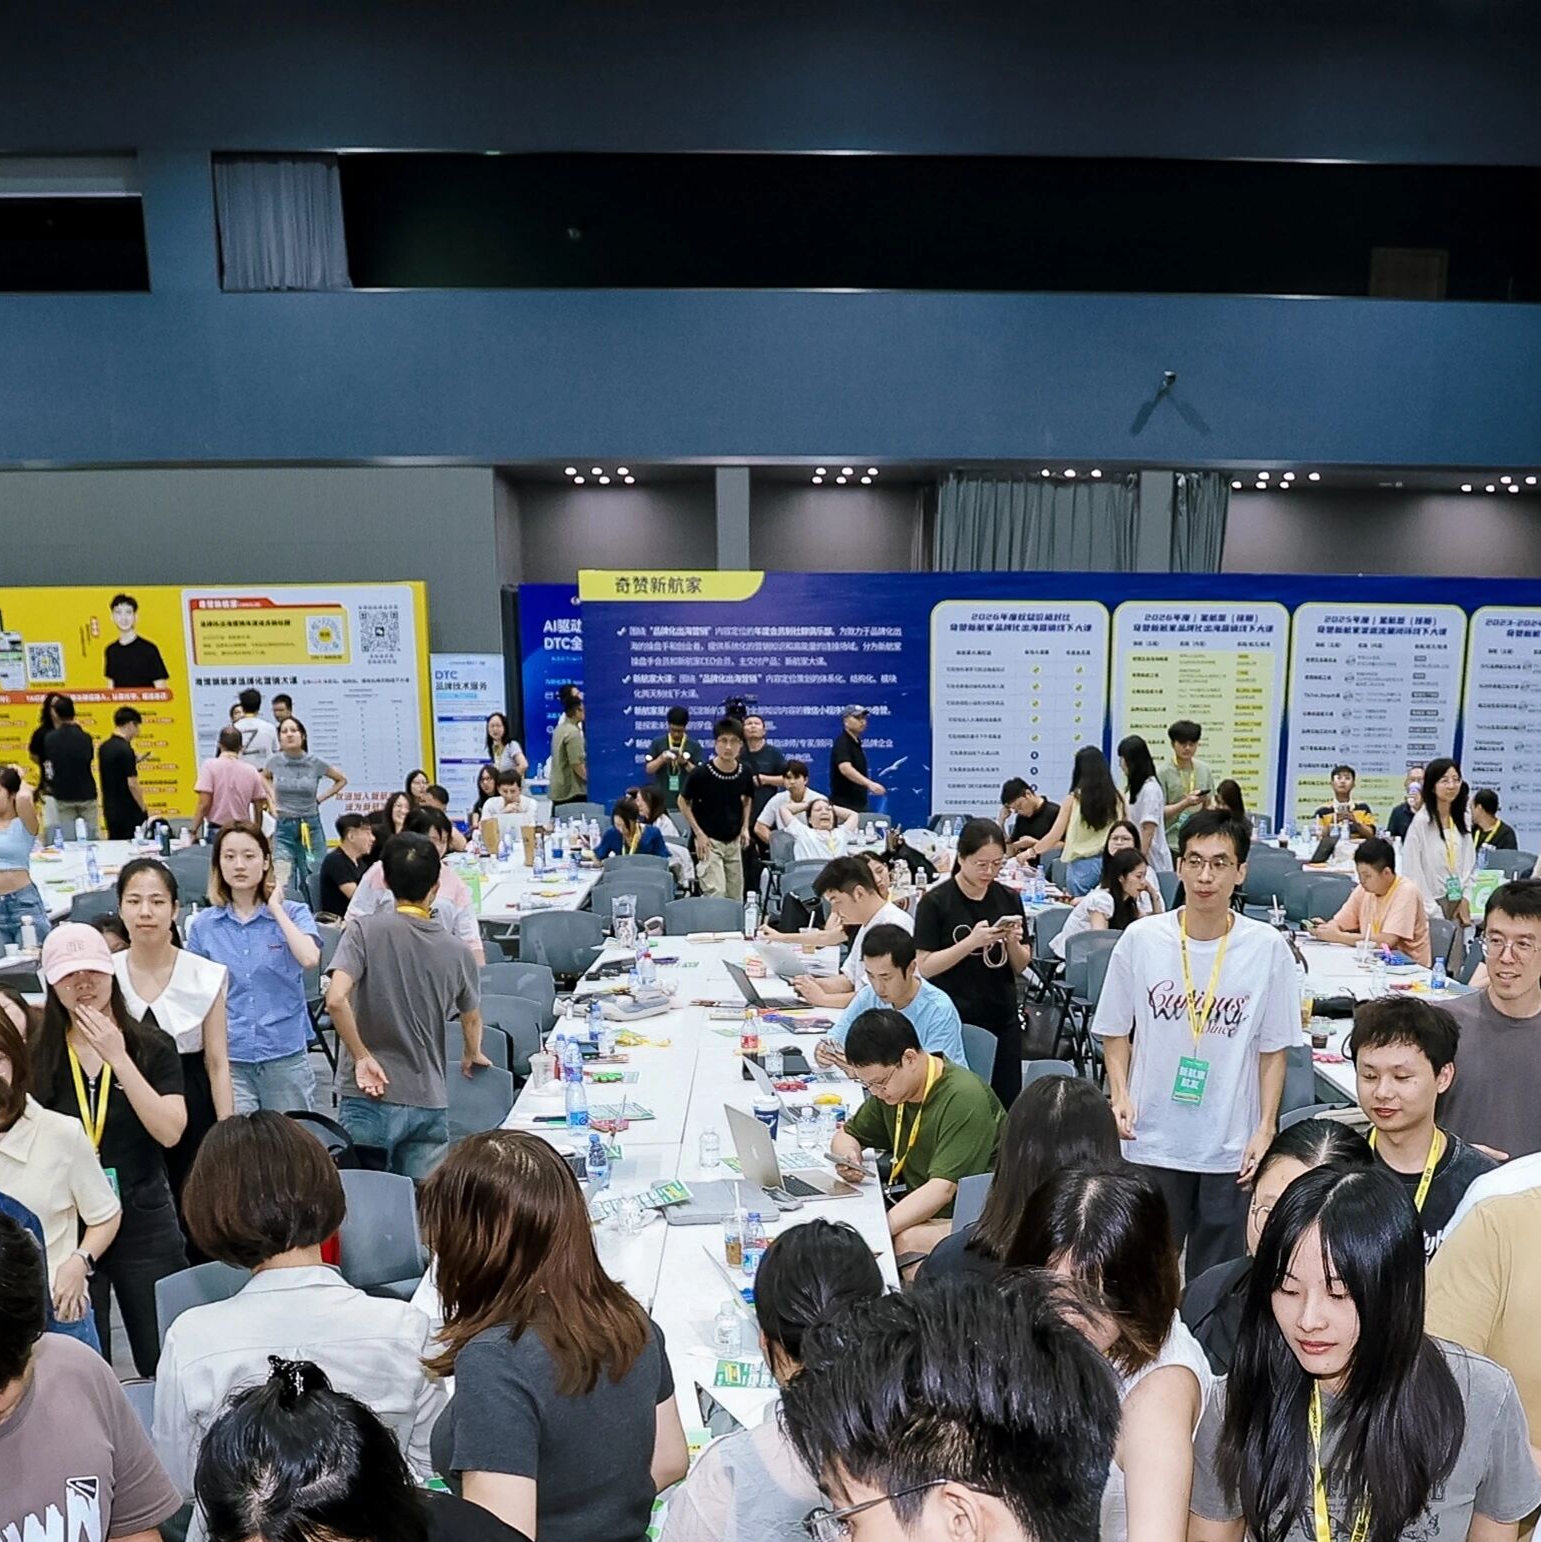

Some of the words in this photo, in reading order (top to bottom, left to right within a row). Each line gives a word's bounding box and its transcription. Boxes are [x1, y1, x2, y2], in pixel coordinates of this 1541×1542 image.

[614, 576, 702, 594] 奇赞新航家
[435, 670, 458, 680] DTC
[435, 681, 488, 691] 品牌技术服务
